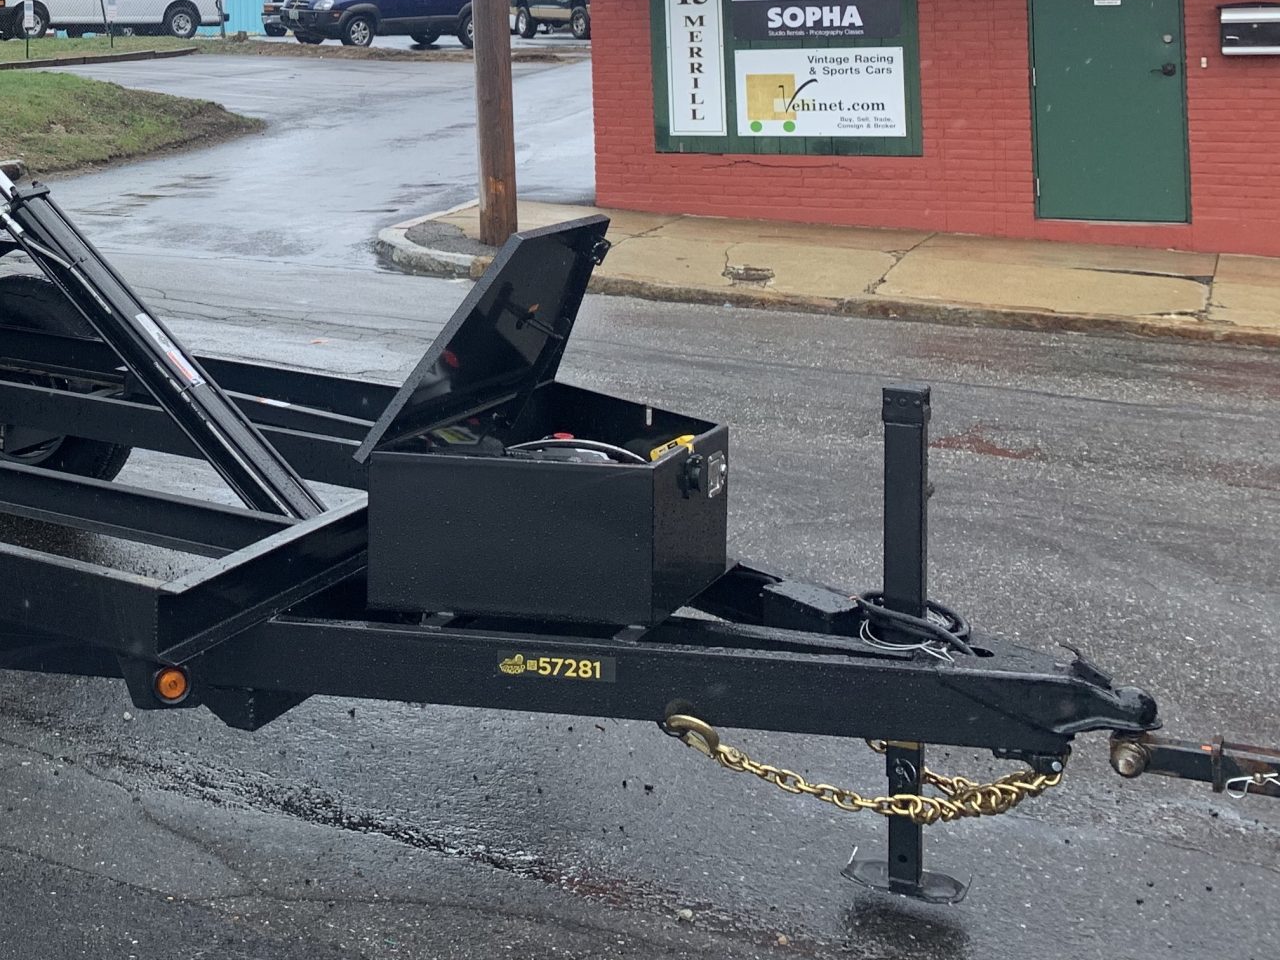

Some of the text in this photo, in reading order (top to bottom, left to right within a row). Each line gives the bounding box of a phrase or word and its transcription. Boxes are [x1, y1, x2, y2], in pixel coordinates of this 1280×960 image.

[767, 5, 864, 28] SOPHA
[809, 28, 843, 37] Photography
[684, 15, 706, 120] MERRILL
[807, 54, 894, 66] Vintage Racing
[809, 65, 893, 77] & Sports Cars
[778, 78, 886, 114] Vehinet.com
[538, 657, 601, 678] 57281
